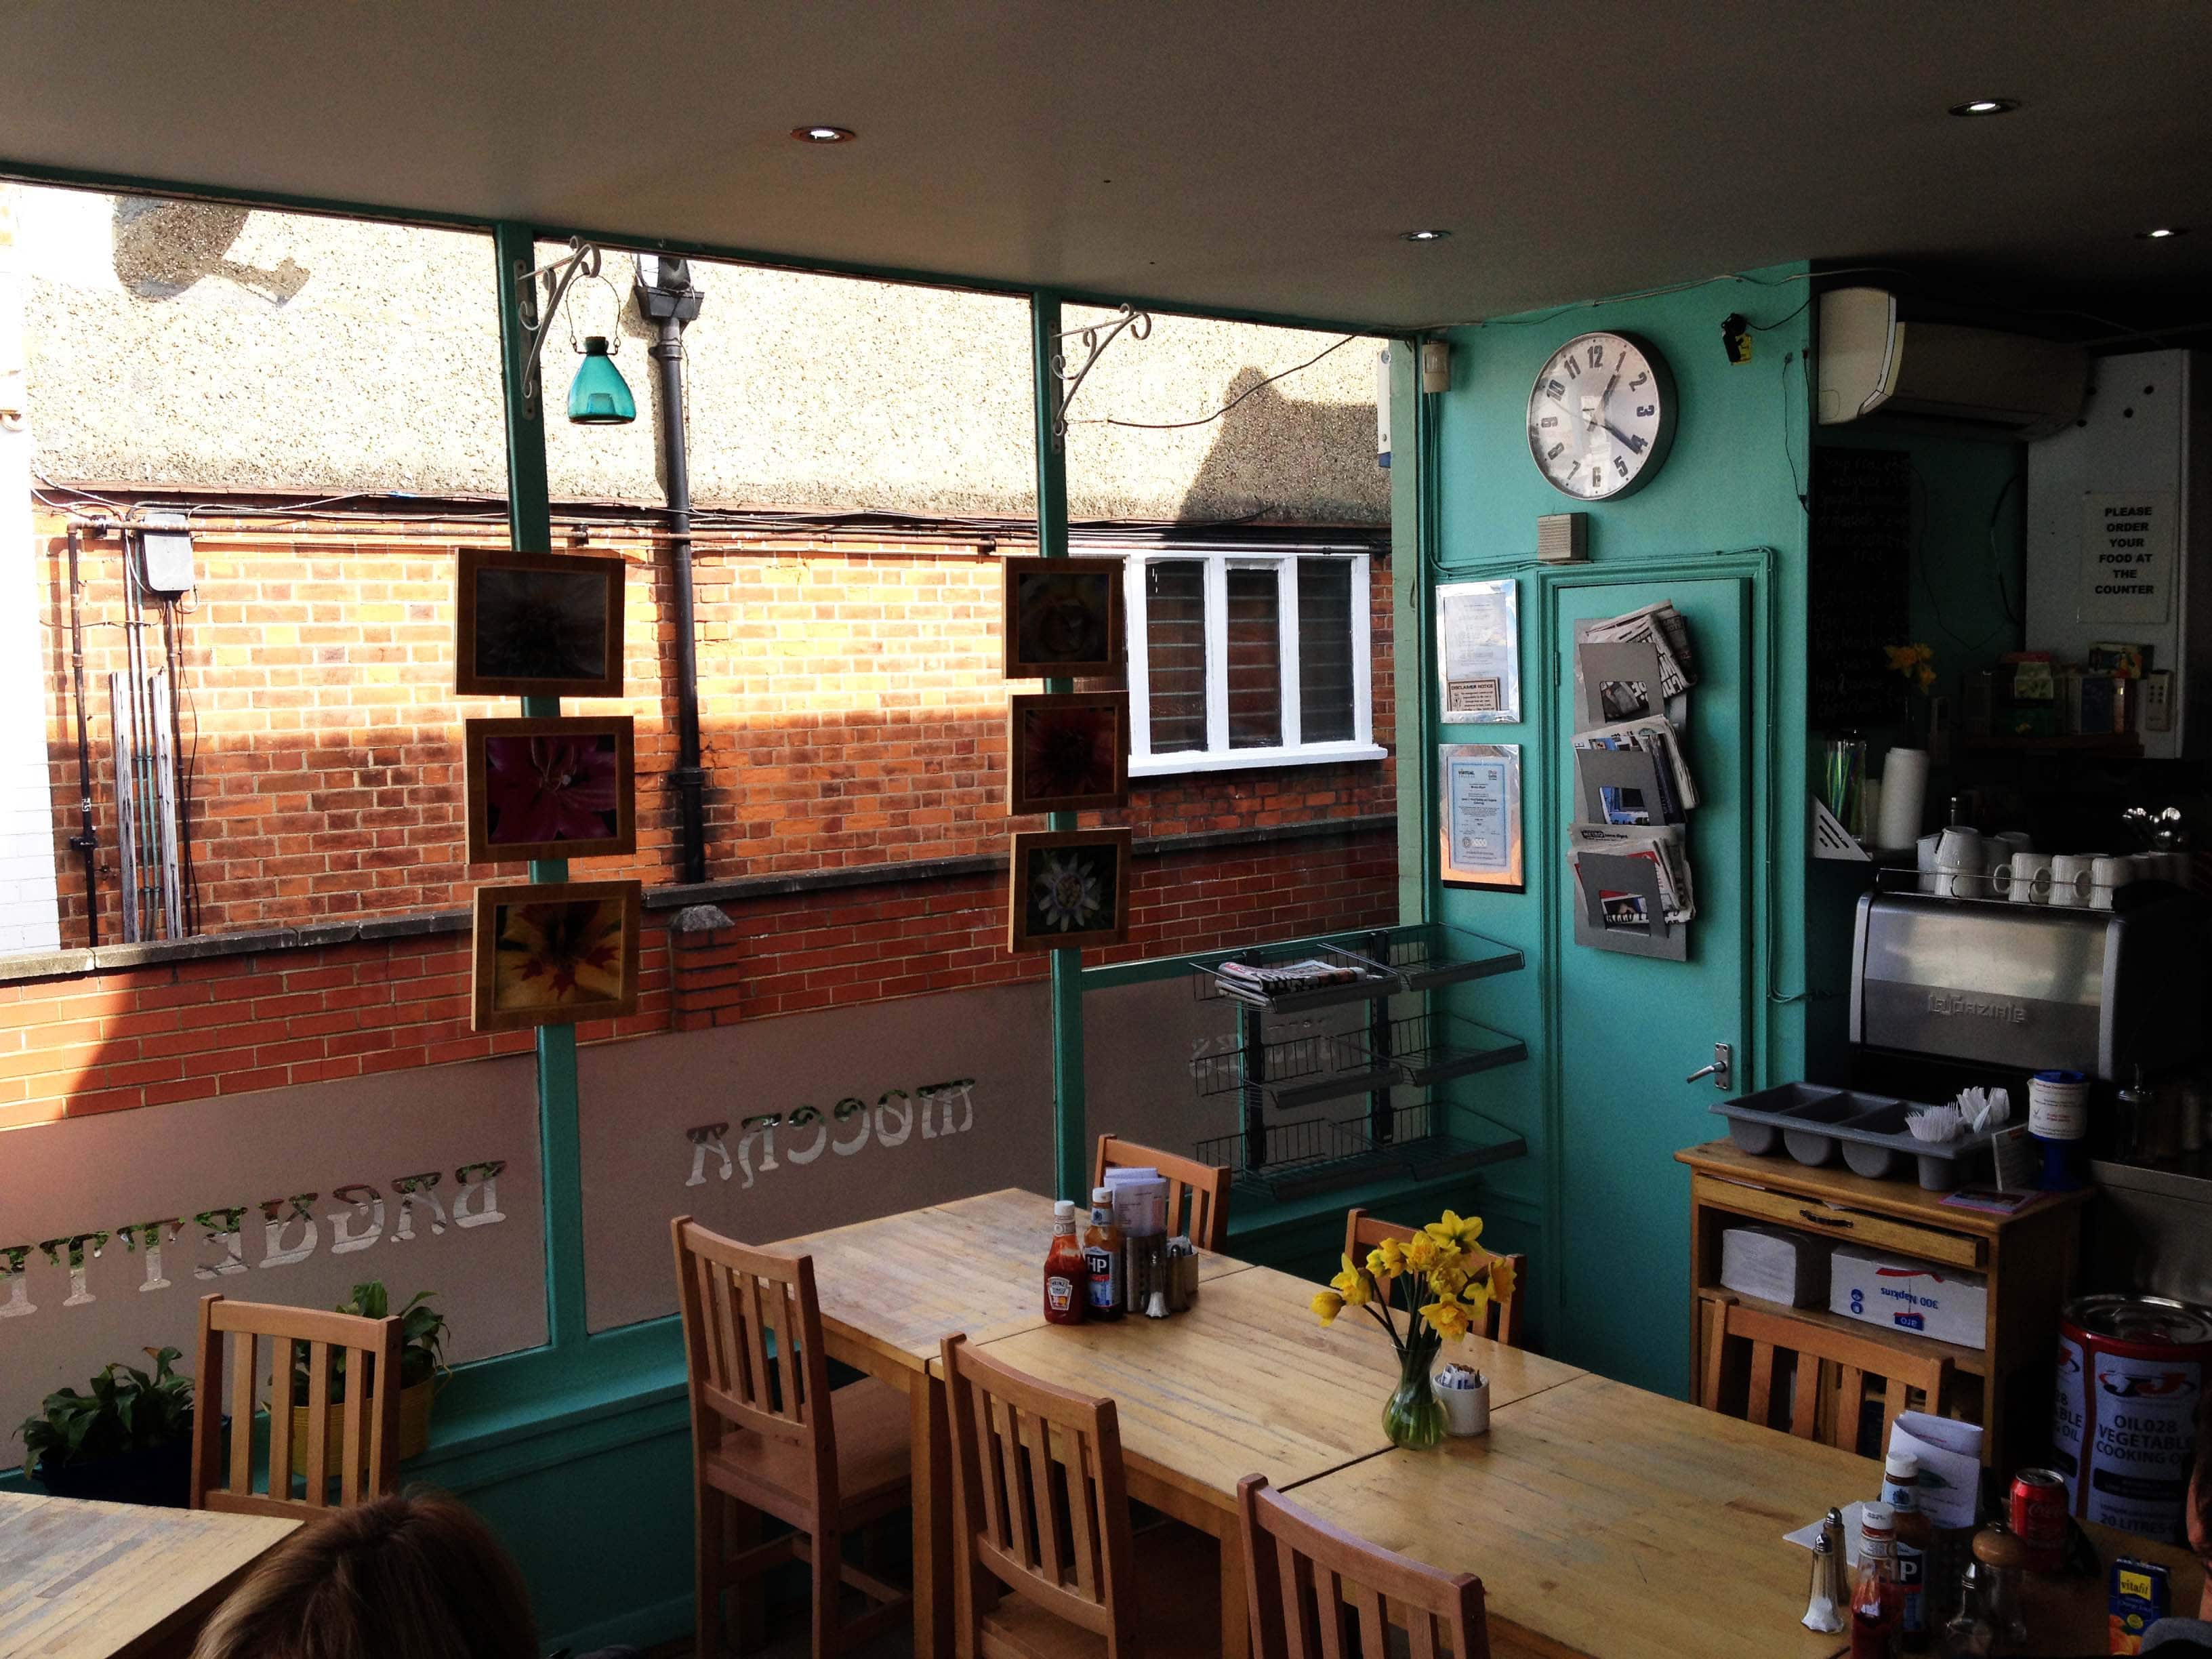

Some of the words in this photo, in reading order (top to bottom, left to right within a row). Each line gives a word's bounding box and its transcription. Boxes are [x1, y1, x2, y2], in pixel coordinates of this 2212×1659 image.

[1587, 345, 1603, 369] 12
[1616, 351, 1626, 372] 1
[1564, 355, 1581, 380] 11
[1547, 379, 1565, 401] 10
[1629, 371, 1647, 392] 2
[1636, 405, 1655, 417] 3
[1541, 416, 1558, 428] 9
[1547, 442, 1564, 460] 8
[1566, 460, 1580, 480] 7
[1614, 455, 1628, 477] 5
[1593, 466, 1601, 487] 6
[2105, 507, 2152, 516] PLEASE
[2106, 523, 2149, 532] ORDER
[2110, 538, 2144, 547] YOUR
[2099, 554, 2132, 563] FOOD
[2136, 554, 2153, 562] AT
[2113, 569, 2137, 578] THE
[2095, 585, 2154, 594] COUNTER
[1087, 1256, 1107, 1273] HP
[1881, 1288, 1917, 1304] Napkins
[1920, 1297, 1938, 1309] 300
[1900, 1317, 1917, 1326] aro
[2114, 1415, 2178, 1433] OIL028
[2062, 1425, 2080, 1443] OIL
[2097, 1441, 2166, 1464] COOKING
[1900, 1560, 1917, 1583] P
